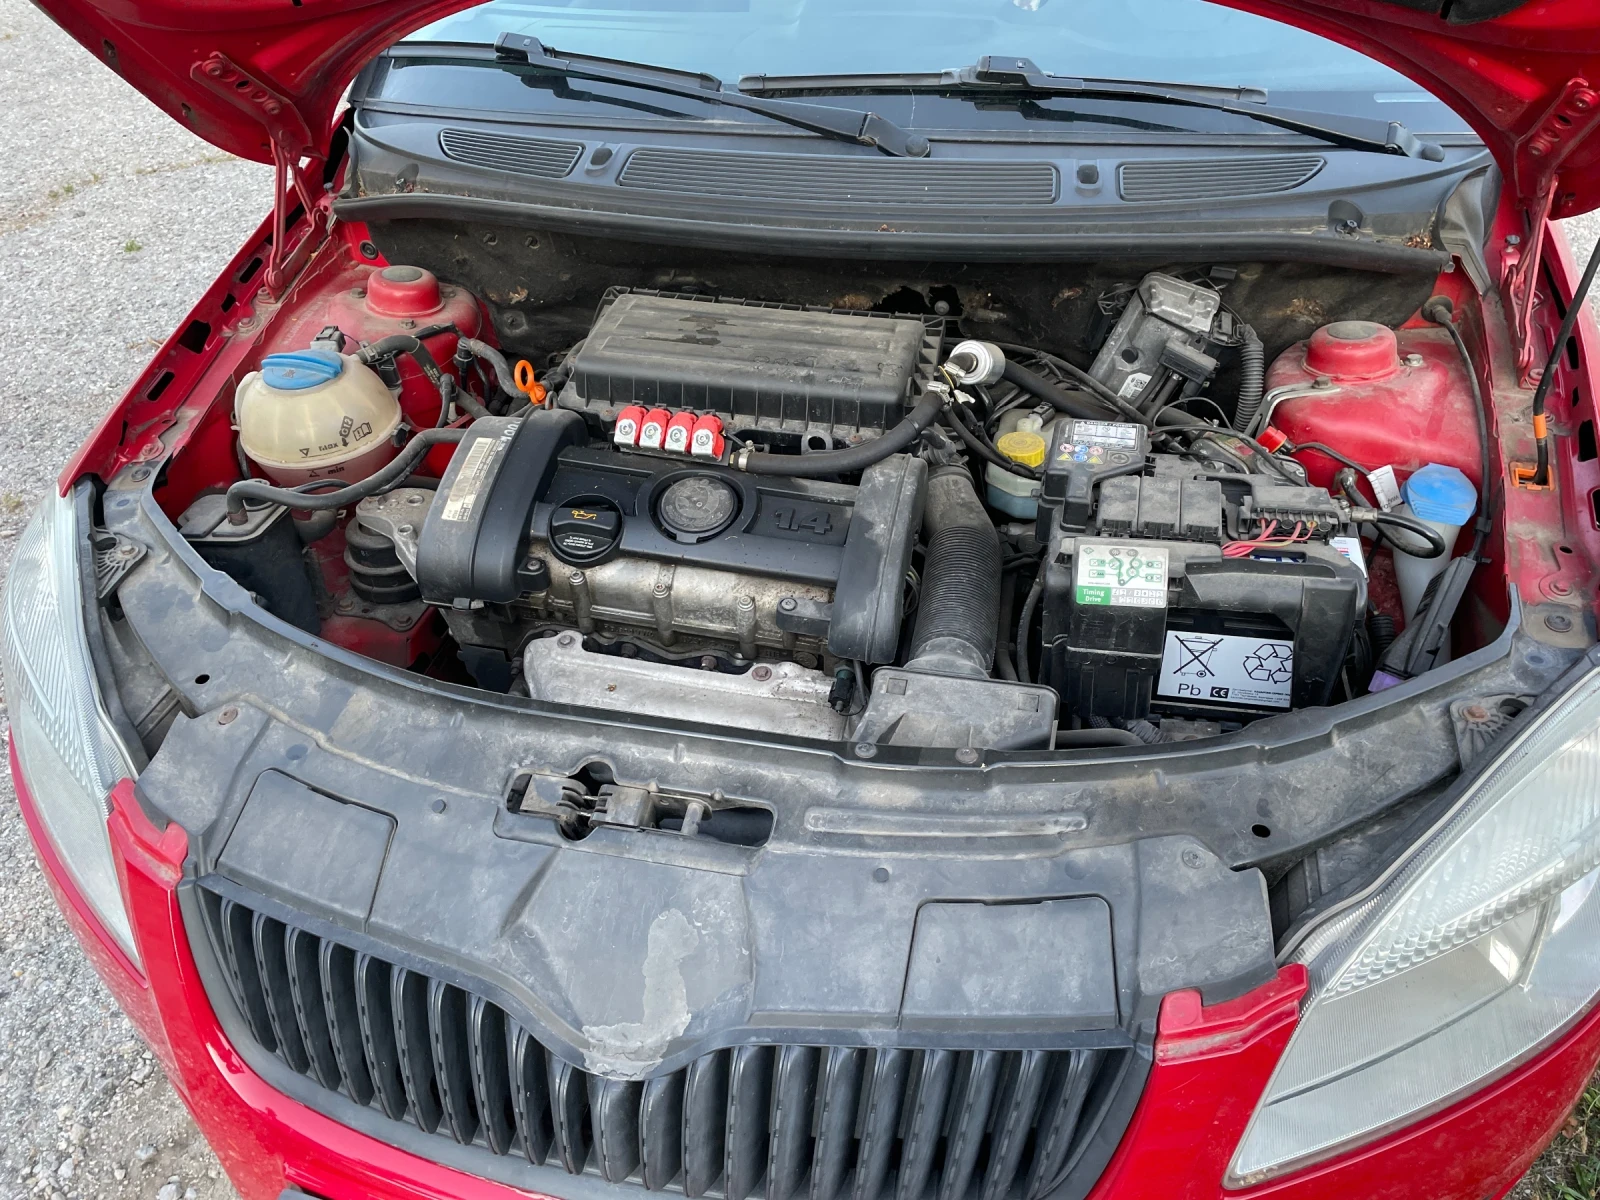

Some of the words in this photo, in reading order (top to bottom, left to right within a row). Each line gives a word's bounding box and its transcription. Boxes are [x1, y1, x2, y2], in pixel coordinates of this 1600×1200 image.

[327, 466, 345, 475] min
[775, 507, 833, 535] 1.4
[1082, 588, 1106, 597] Timing
[1085, 595, 1102, 603] Drive
[1178, 683, 1201, 696] Pb
